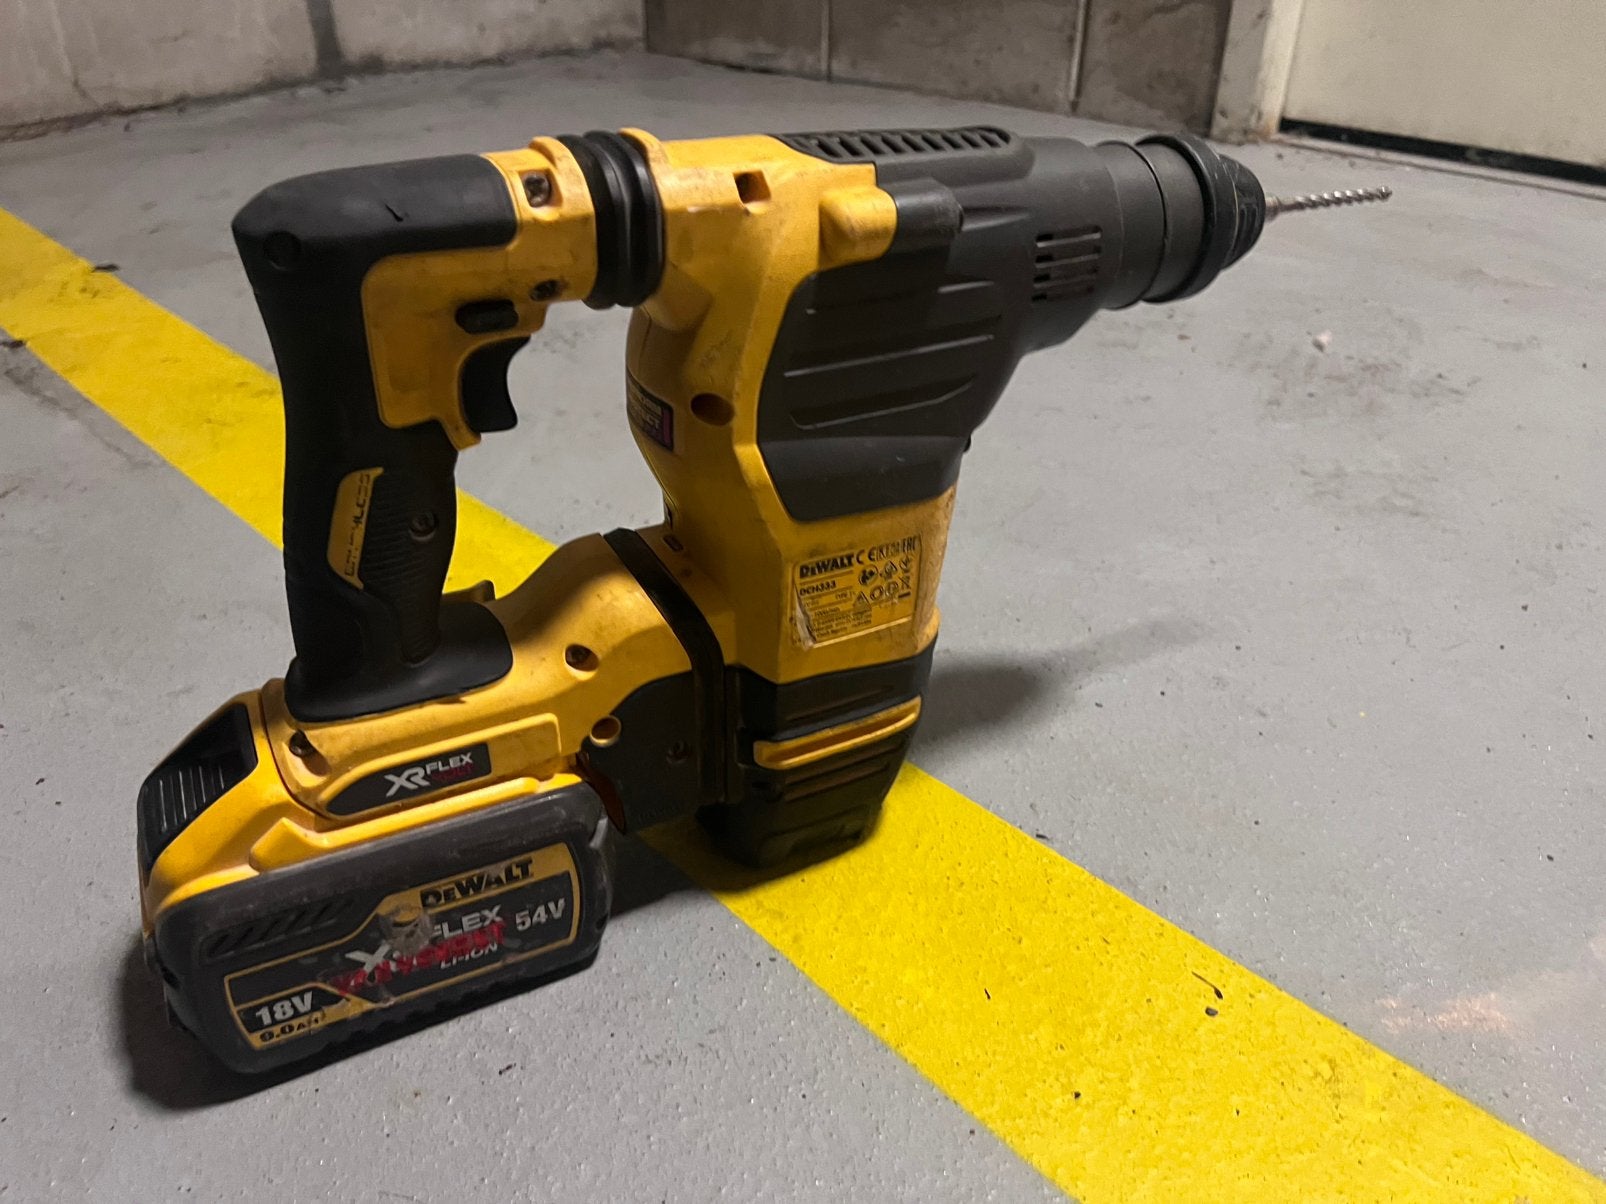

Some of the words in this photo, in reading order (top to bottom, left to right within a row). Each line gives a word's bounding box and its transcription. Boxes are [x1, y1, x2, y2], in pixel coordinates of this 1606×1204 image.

[384, 766, 431, 798] XR
[425, 752, 474, 776] FLEX
[515, 897, 566, 933] 54V
[255, 990, 314, 1027] 18V
